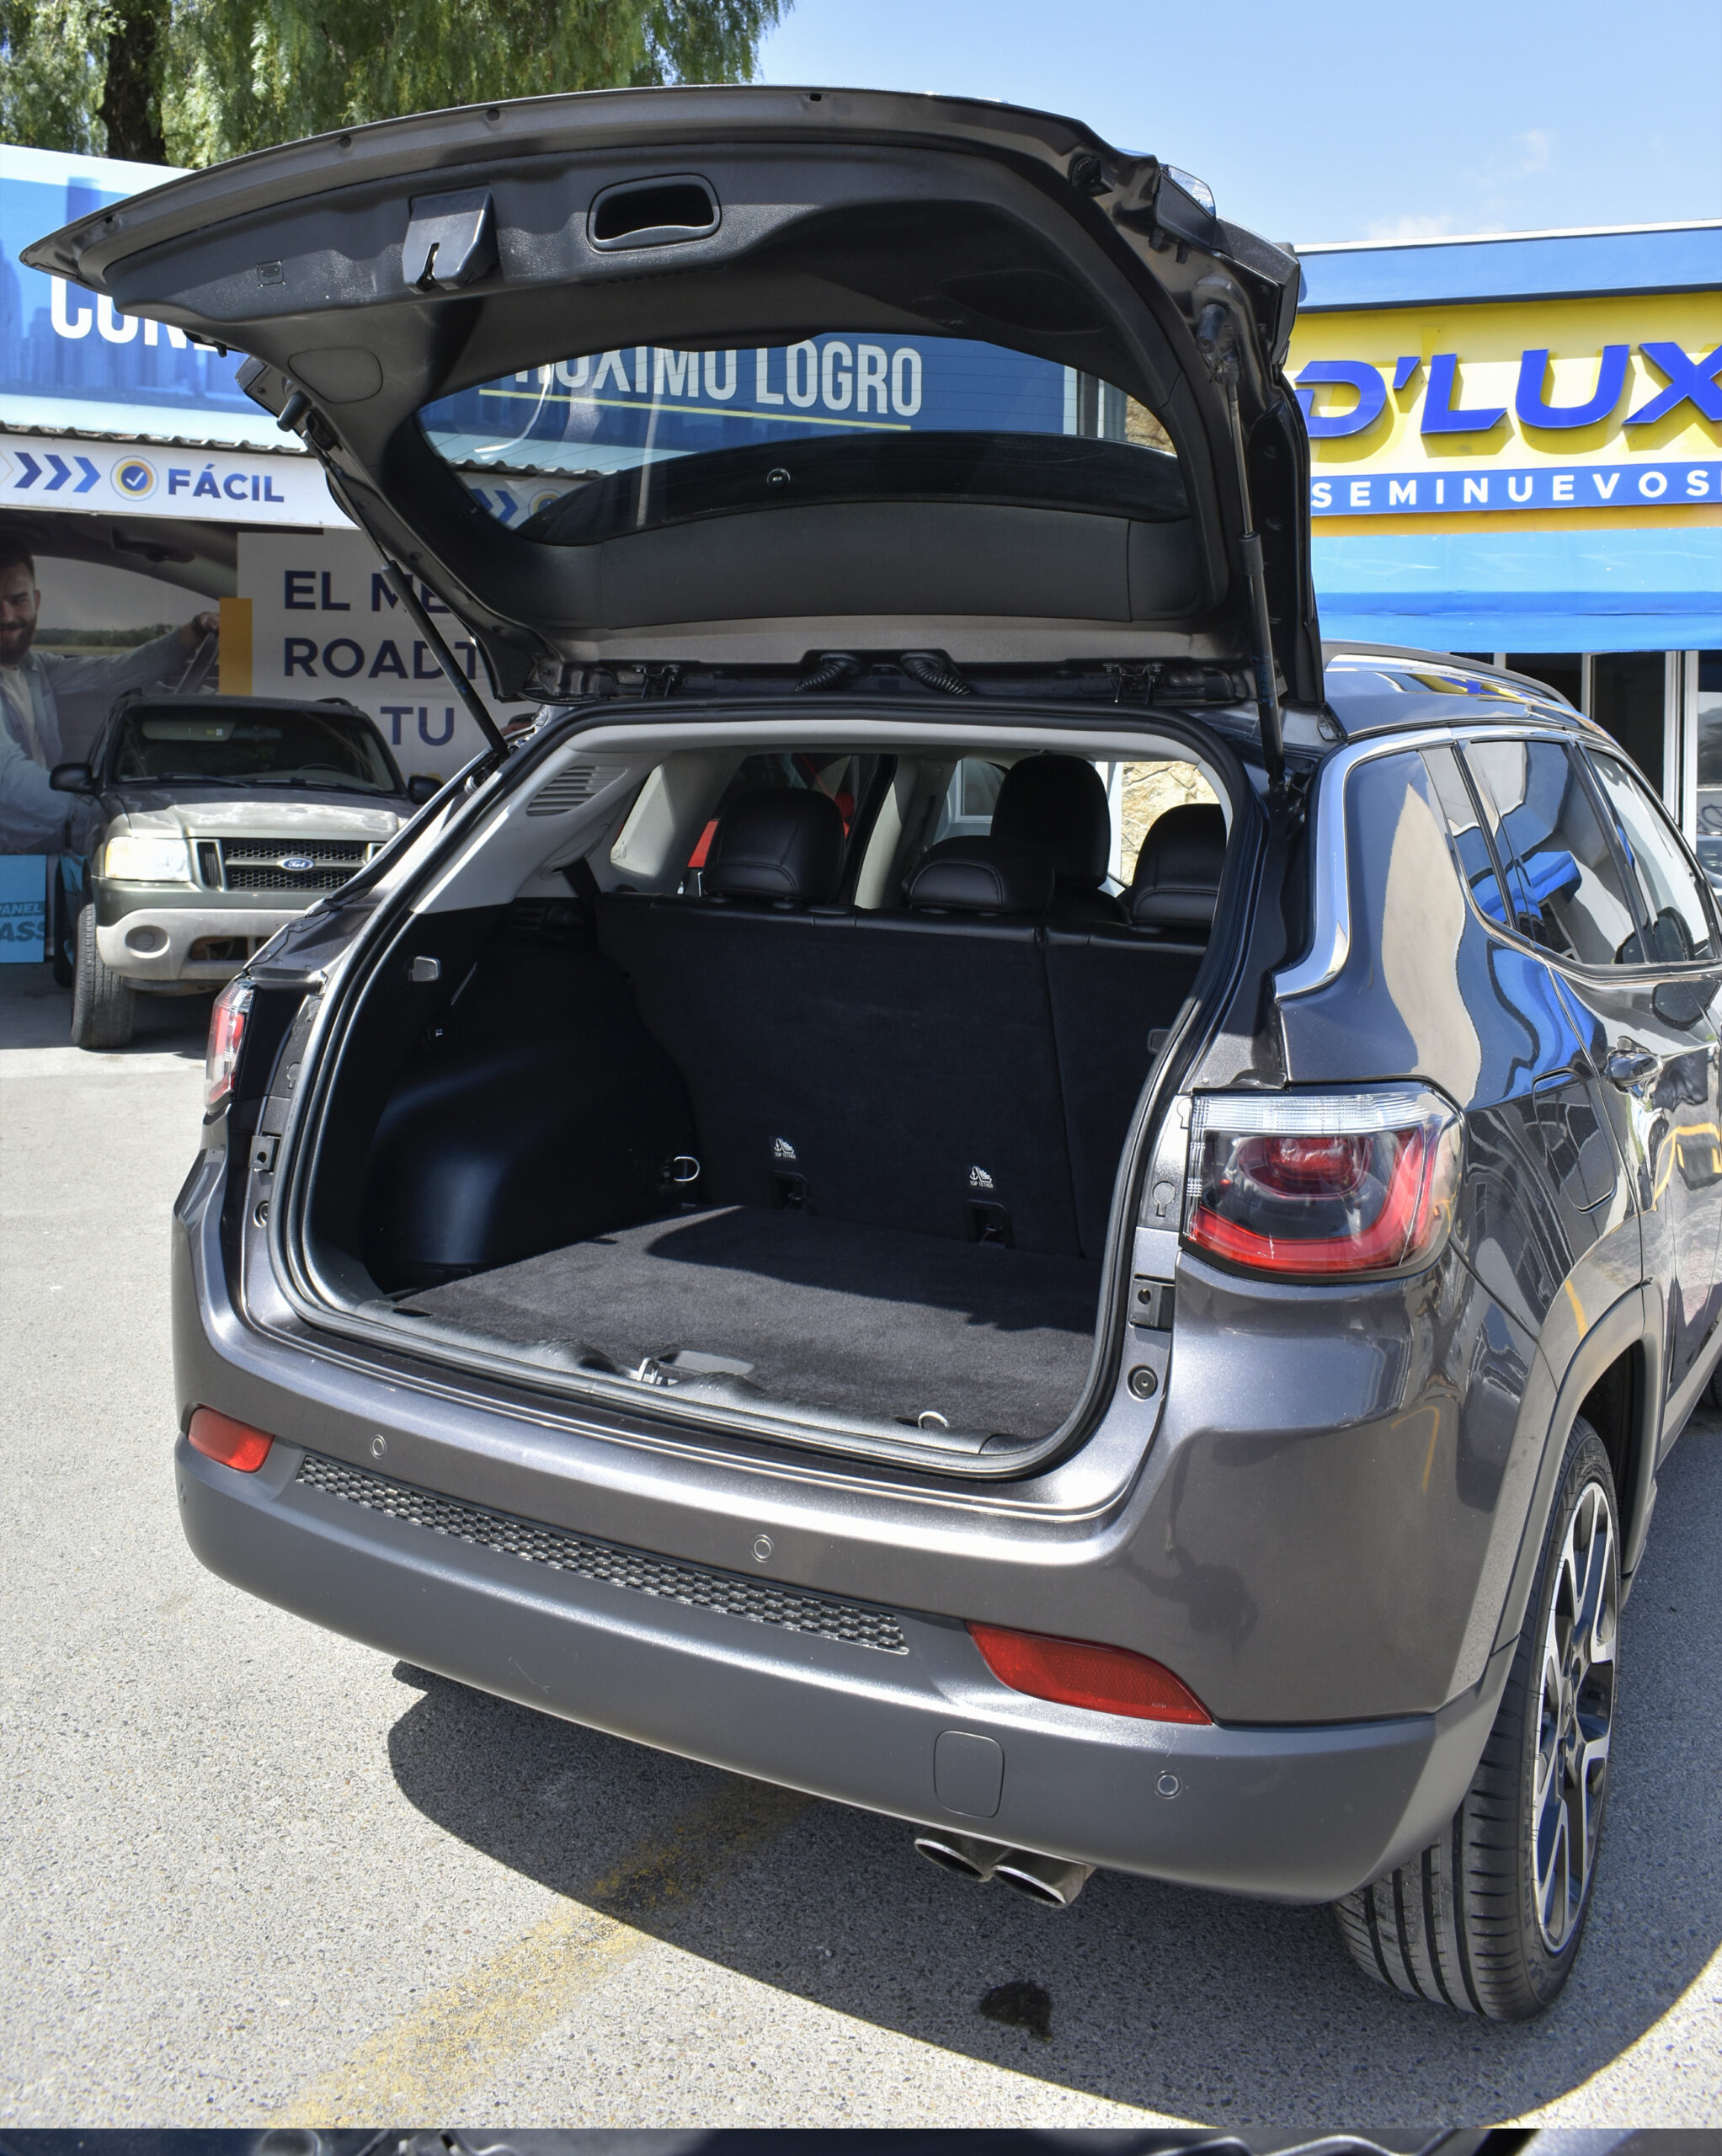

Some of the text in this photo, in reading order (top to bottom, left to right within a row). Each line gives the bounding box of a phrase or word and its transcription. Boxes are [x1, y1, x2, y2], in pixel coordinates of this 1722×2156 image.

[756, 339, 922, 417] LOGRO
[168, 463, 285, 503] FÁCIL
[1310, 469, 1710, 508] SEMINUEVOS
[285, 570, 350, 611] EL
[381, 706, 455, 746] TU
[0, 903, 41, 915] ANEL
